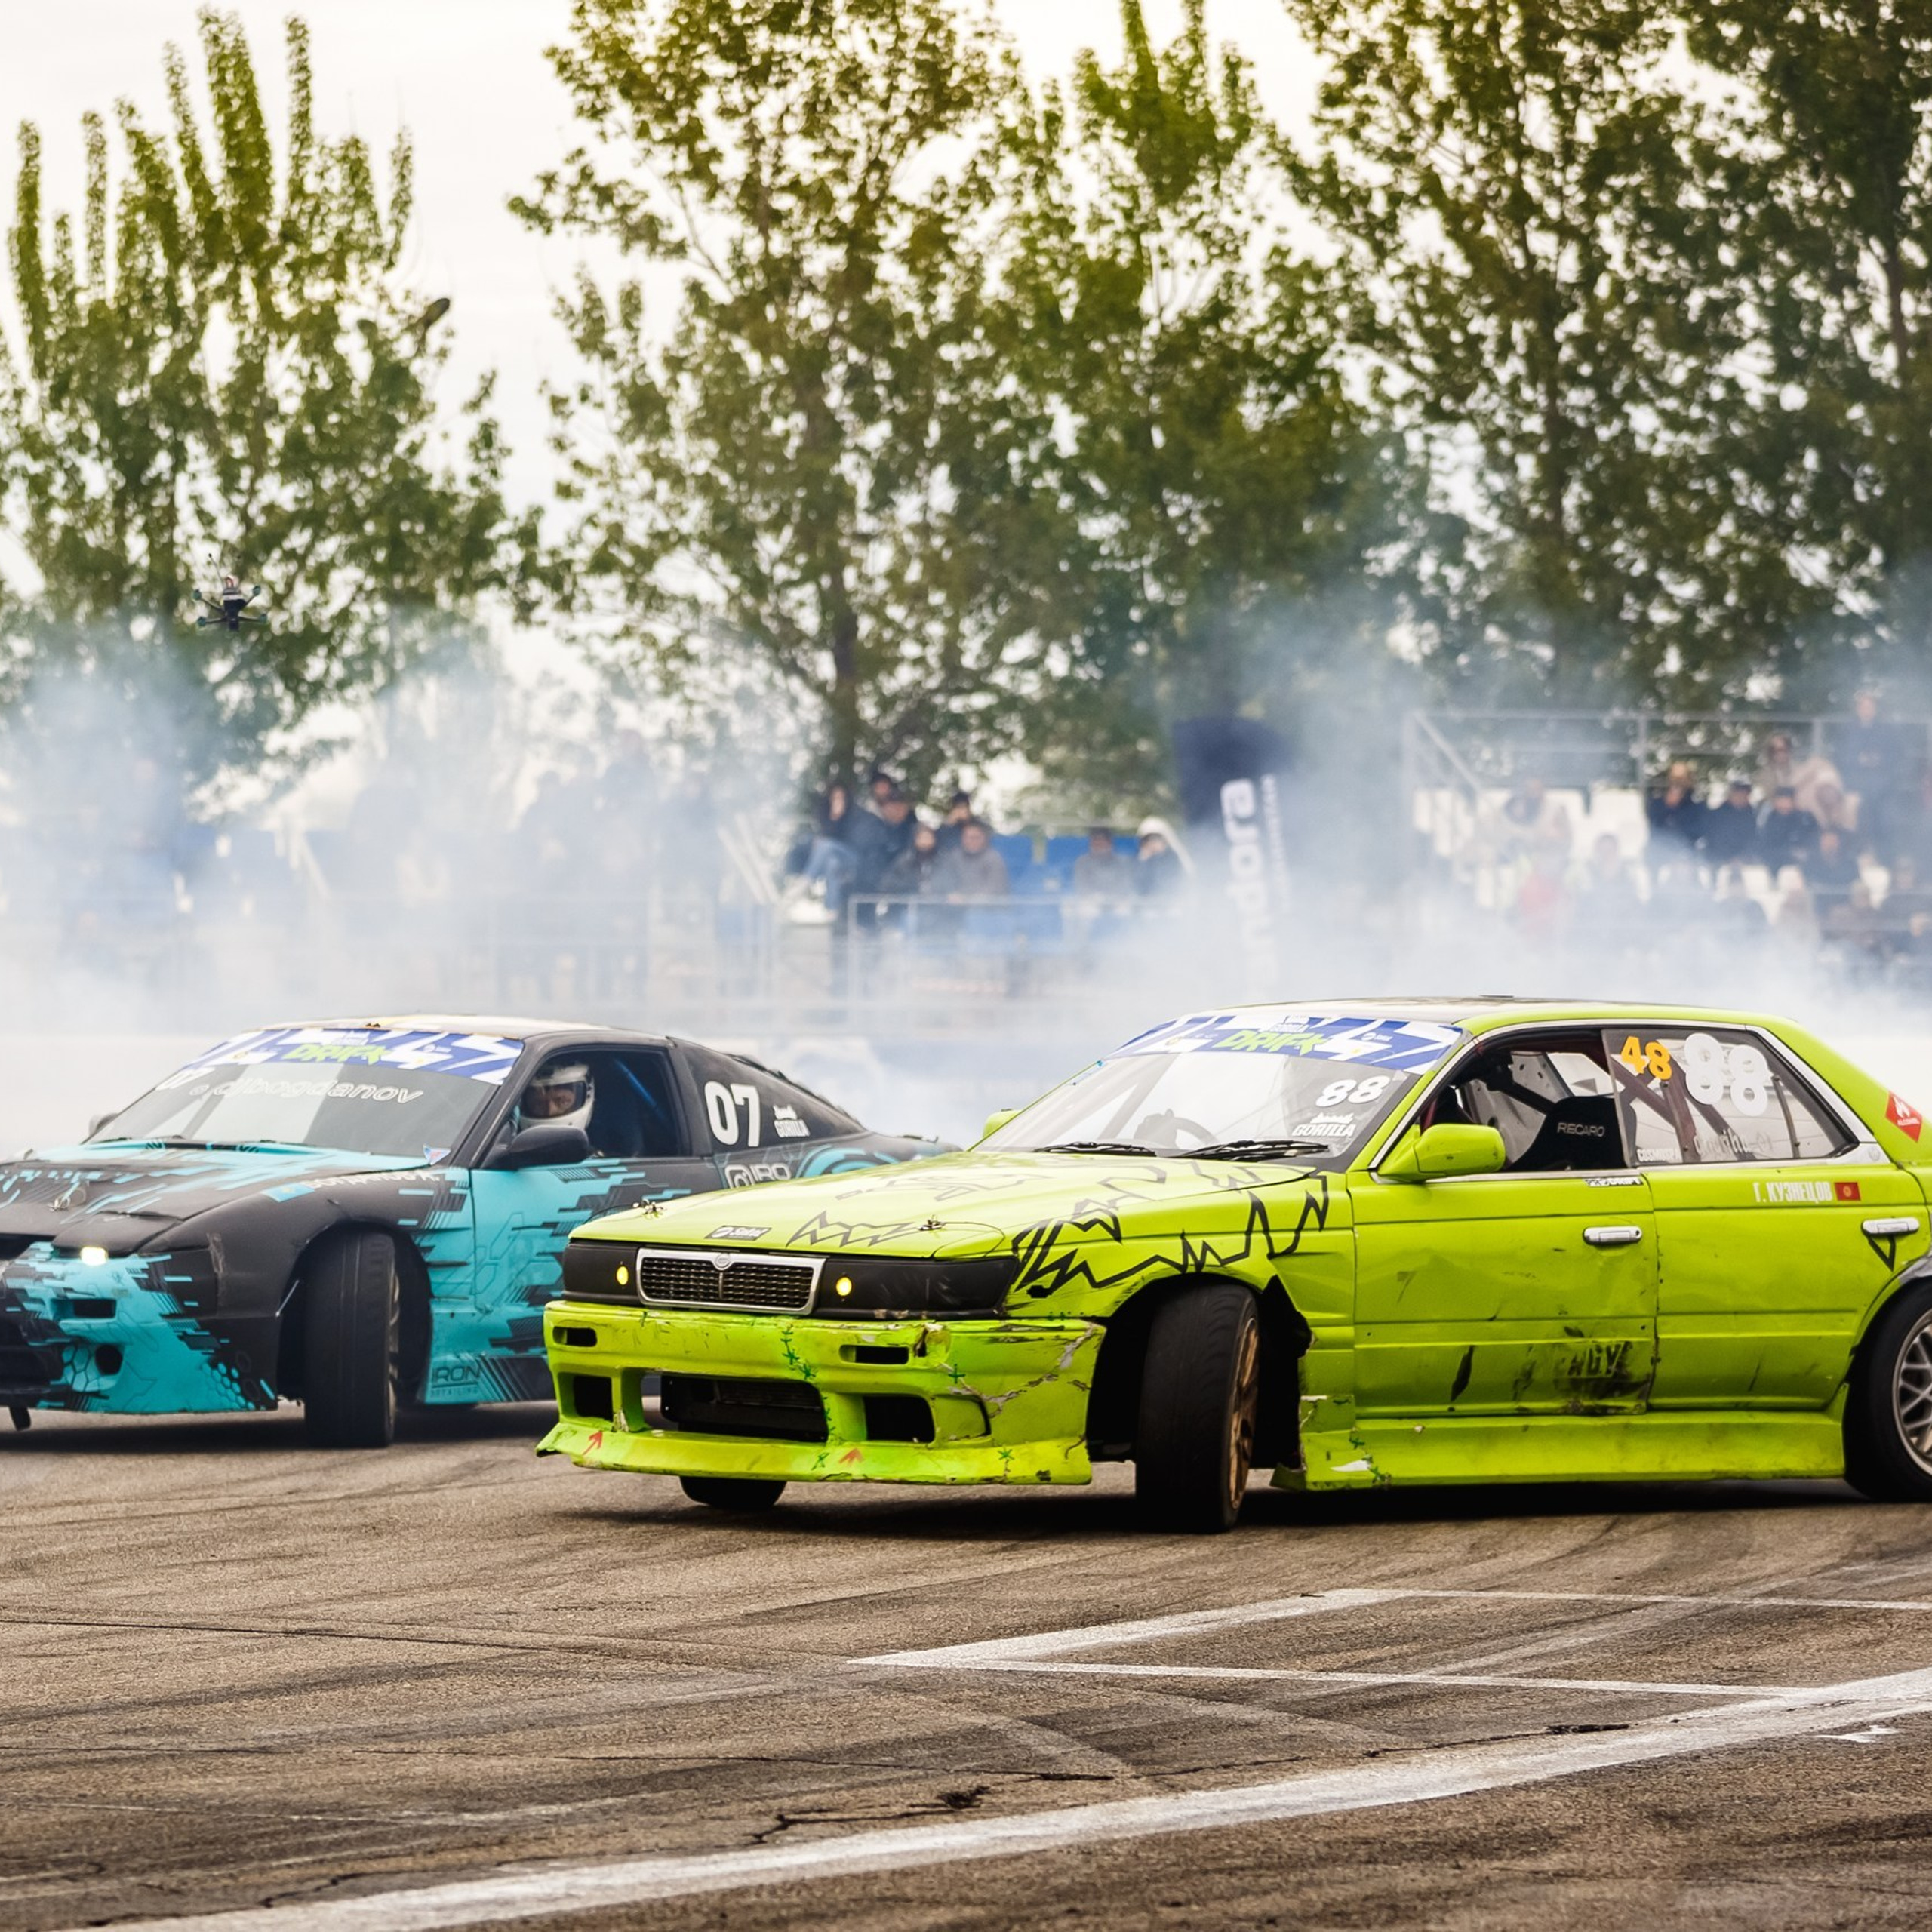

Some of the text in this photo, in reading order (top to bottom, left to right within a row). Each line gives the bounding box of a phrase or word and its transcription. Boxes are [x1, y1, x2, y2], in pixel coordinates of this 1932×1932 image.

[281, 1044, 393, 1065] DRIFT
[1212, 1029, 1329, 1056] DRIFT
[1620, 1035, 1672, 1080] 48
[1684, 1032, 1768, 1117] 88
[1315, 1075, 1390, 1107] 88
[703, 1080, 761, 1147] 07
[1291, 1123, 1356, 1137] GORILLA
[1557, 1121, 1605, 1137] RECARO
[1766, 1181, 1833, 1204] КУЗНЕЦОВ
[432, 1364, 481, 1383] IRON
